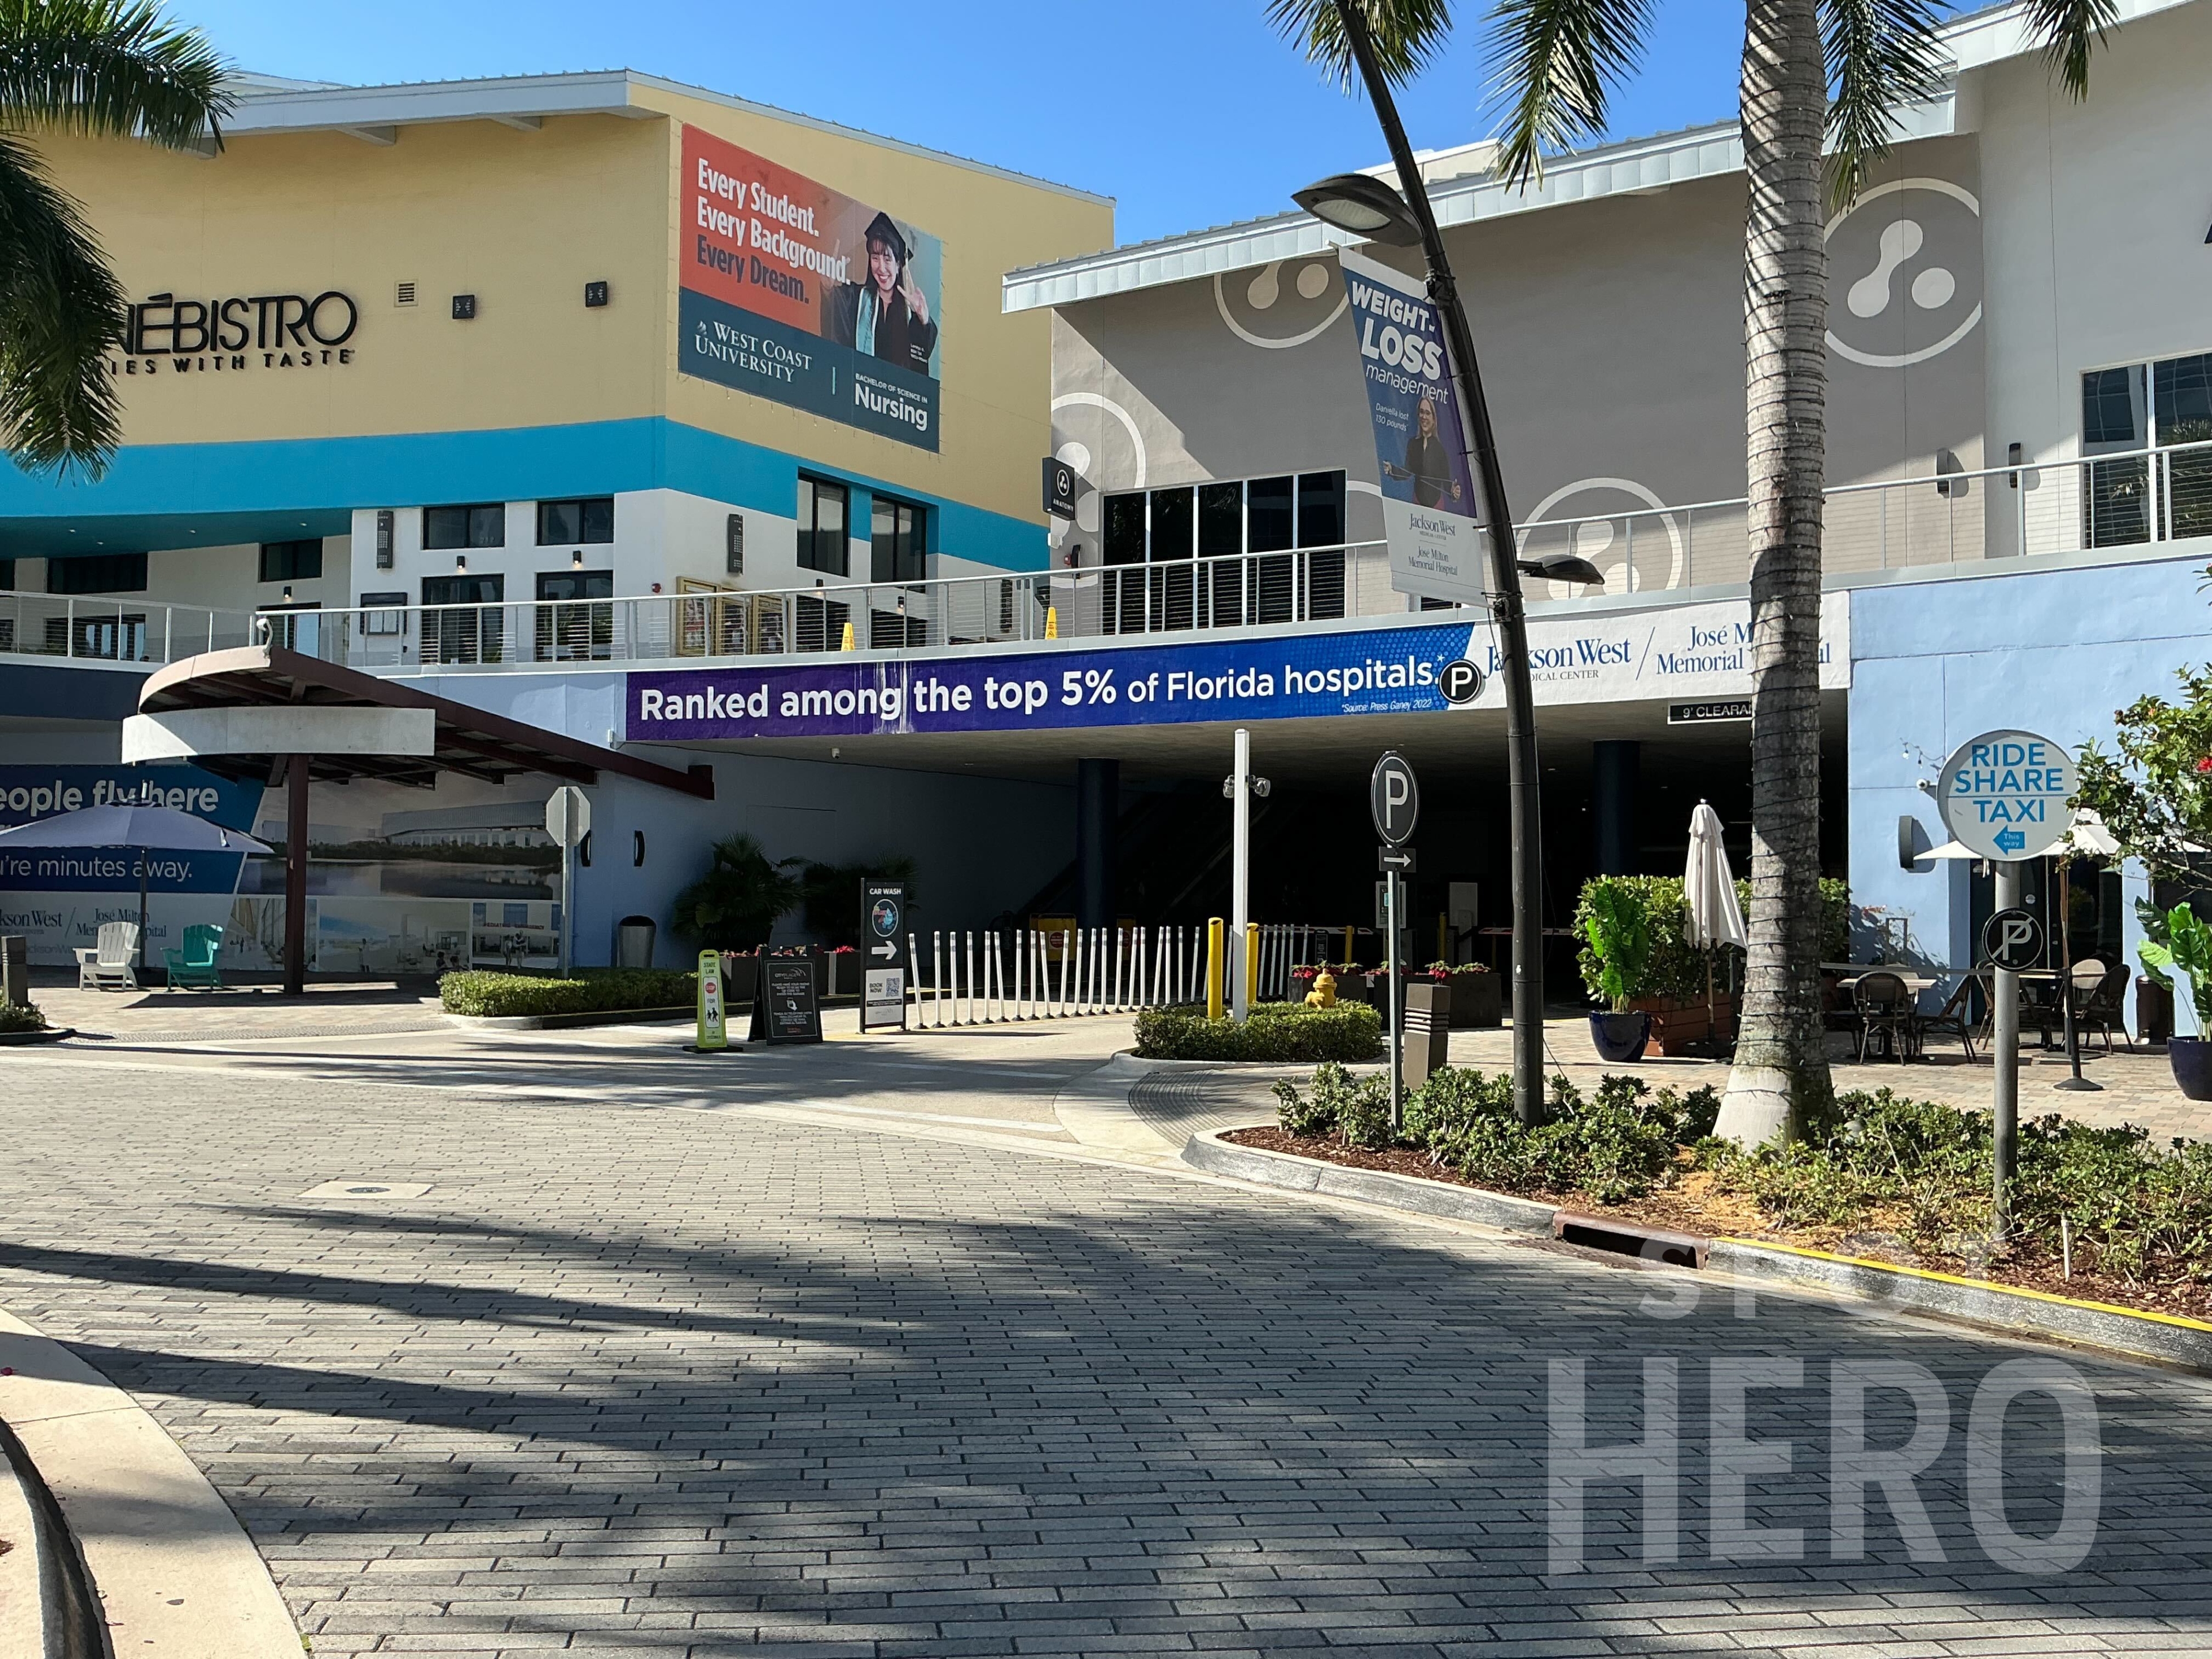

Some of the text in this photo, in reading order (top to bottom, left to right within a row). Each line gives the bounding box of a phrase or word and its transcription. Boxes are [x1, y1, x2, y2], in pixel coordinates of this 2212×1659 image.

[698, 157, 819, 237] Every Student.
[698, 195, 850, 285] Every Background.
[697, 234, 809, 304] Every Dream.
[1352, 281, 1435, 333] WEIGHT-
[173, 355, 245, 373] WITH
[263, 349, 351, 368] TASTE
[1361, 317, 1443, 380] LOSS
[855, 373, 887, 390] BACHELOR
[897, 388, 921, 402] SCIENCE
[1366, 364, 1449, 404] management
[855, 383, 927, 431] Nursing
[1376, 403, 1409, 421] Daniella lost
[1376, 414, 1386, 424] 130
[1052, 498, 1074, 512] ANATOMY
[1409, 513, 1456, 536] Jackson West
[1408, 556, 1458, 577] Memorial Hospital
[1418, 546, 1449, 562] José Milton
[1687, 625, 1728, 651] José
[1483, 638, 1631, 679] Jason West
[1656, 647, 1744, 675] Memorial
[1450, 666, 1474, 697] P
[1559, 669, 1599, 680] CENTER
[641, 684, 768, 721] Ranked
[780, 687, 902, 720] among
[914, 677, 972, 712] the
[984, 677, 1049, 714] top
[1061, 669, 1116, 706] 5%
[1127, 672, 1159, 702] of
[1167, 666, 1275, 701] Florida
[1370, 702, 1388, 711] Press
[1390, 700, 1411, 711] Ganey
[1412, 699, 1433, 709] 2022
[1682, 703, 1752, 719] 9' CLEARA
[1971, 743, 2047, 767] RIDE
[1955, 768, 2064, 793] SHARE
[93, 779, 136, 806] fly
[149, 779, 219, 813] here
[1385, 770, 1409, 830] P
[1973, 799, 2045, 824] TAXI
[38, 855, 126, 877] minutes
[132, 861, 192, 882] away.
[31, 910, 62, 927] West
[94, 908, 150, 923] José Miltn
[2002, 920, 2032, 961] P
